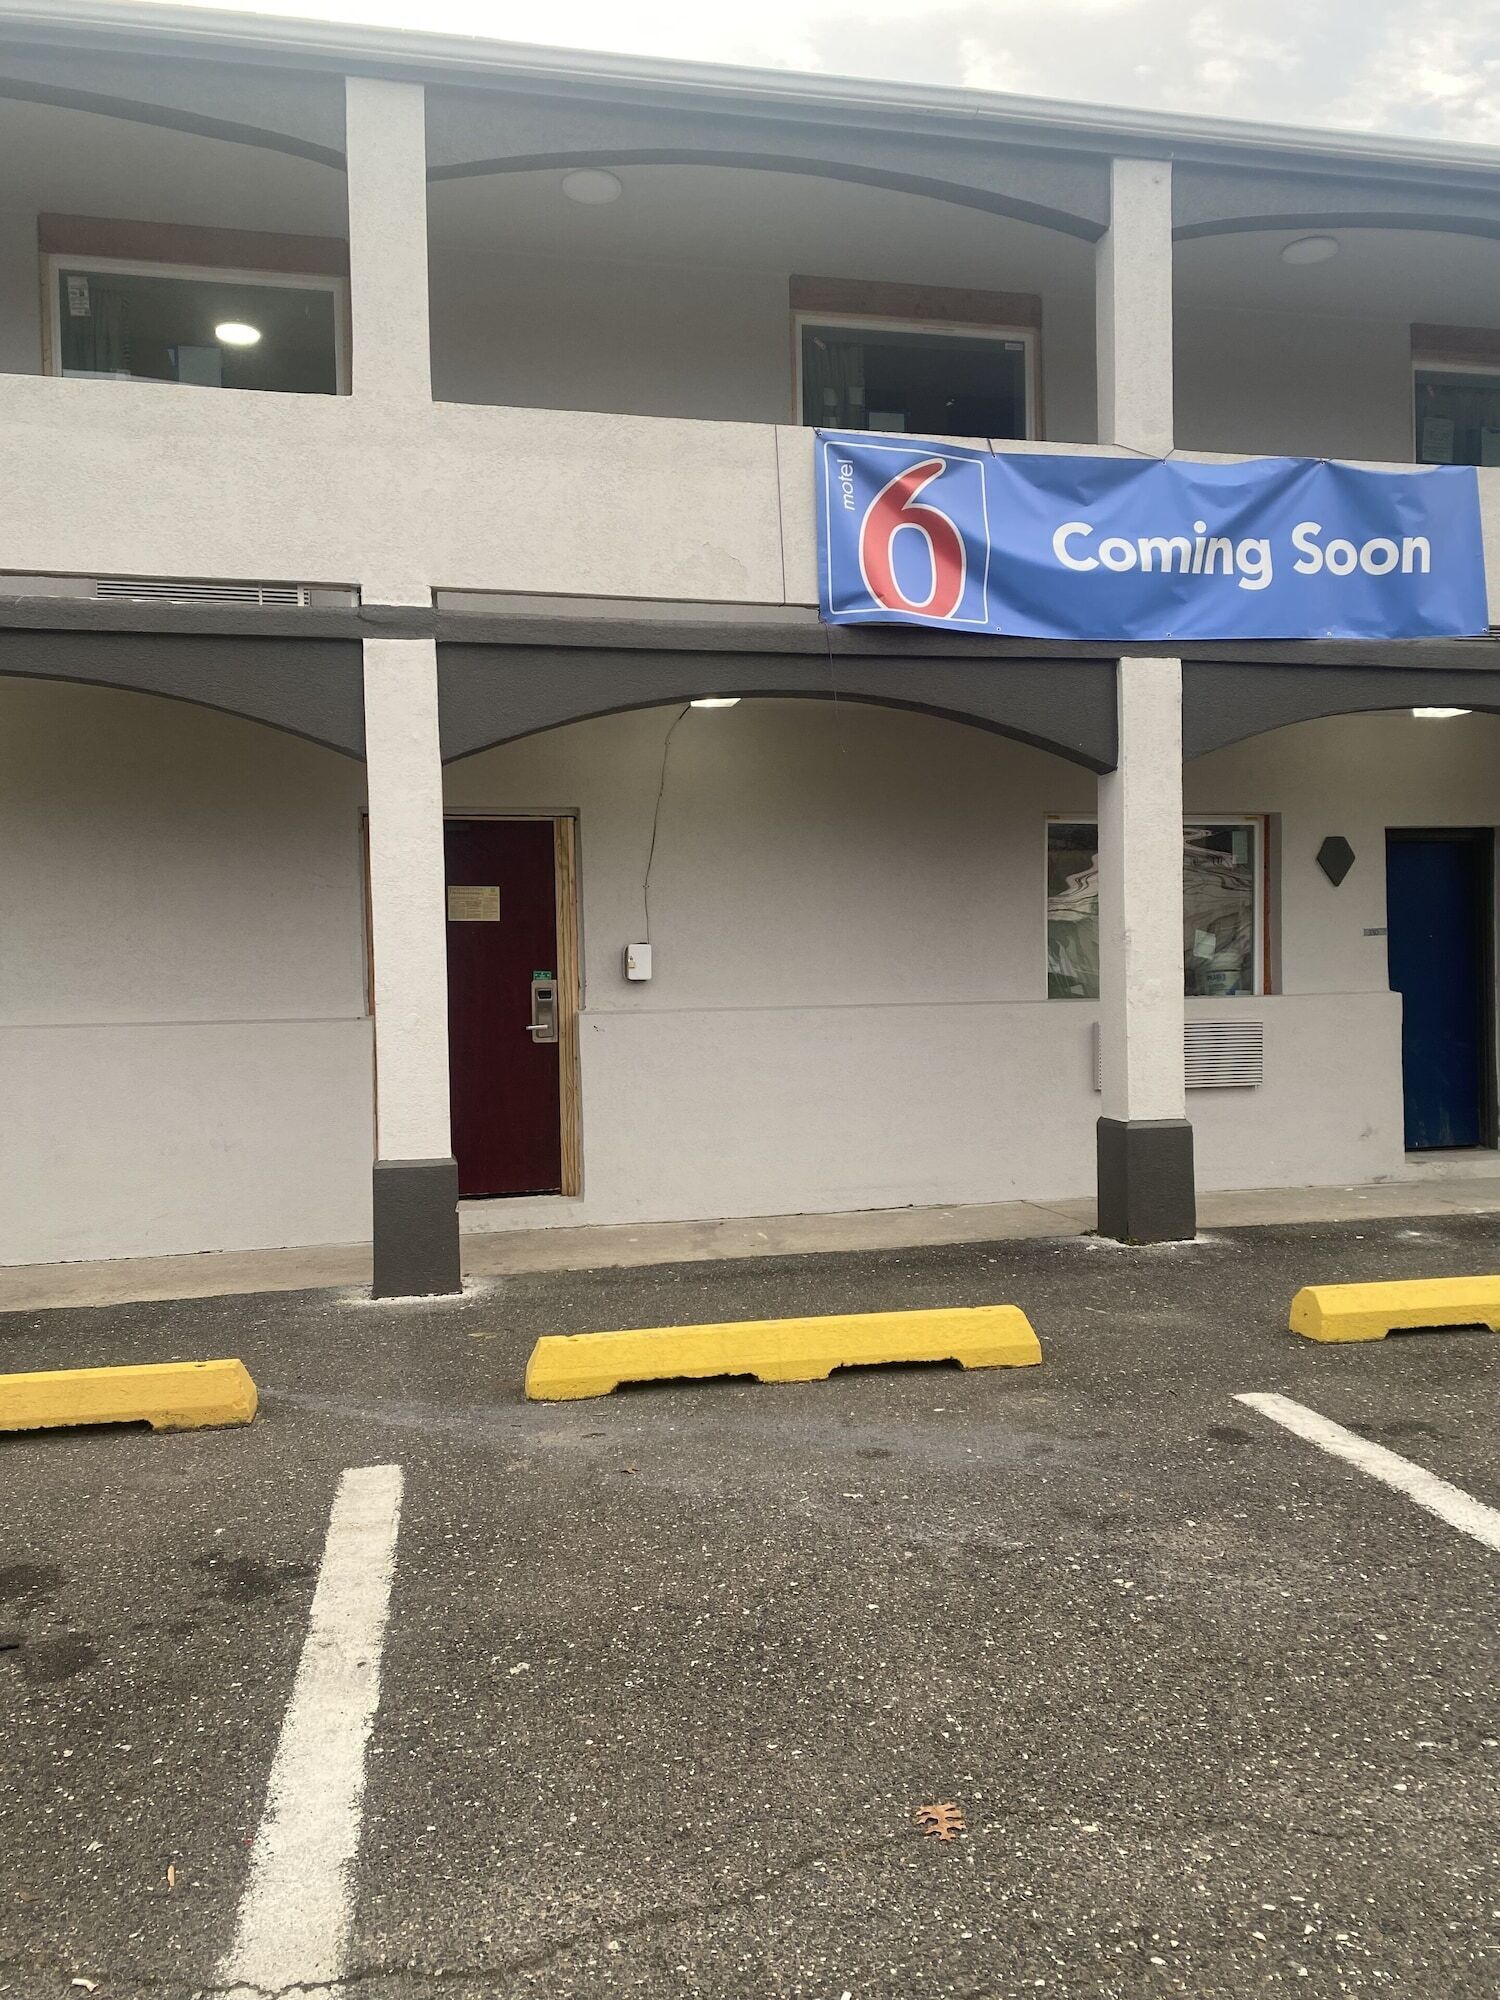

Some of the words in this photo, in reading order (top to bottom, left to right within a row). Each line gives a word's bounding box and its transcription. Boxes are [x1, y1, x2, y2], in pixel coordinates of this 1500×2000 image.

[837, 459, 855, 511] motel
[858, 457, 967, 619] 6
[1052, 520, 1273, 590] Coming
[1291, 521, 1431, 576] Soon
